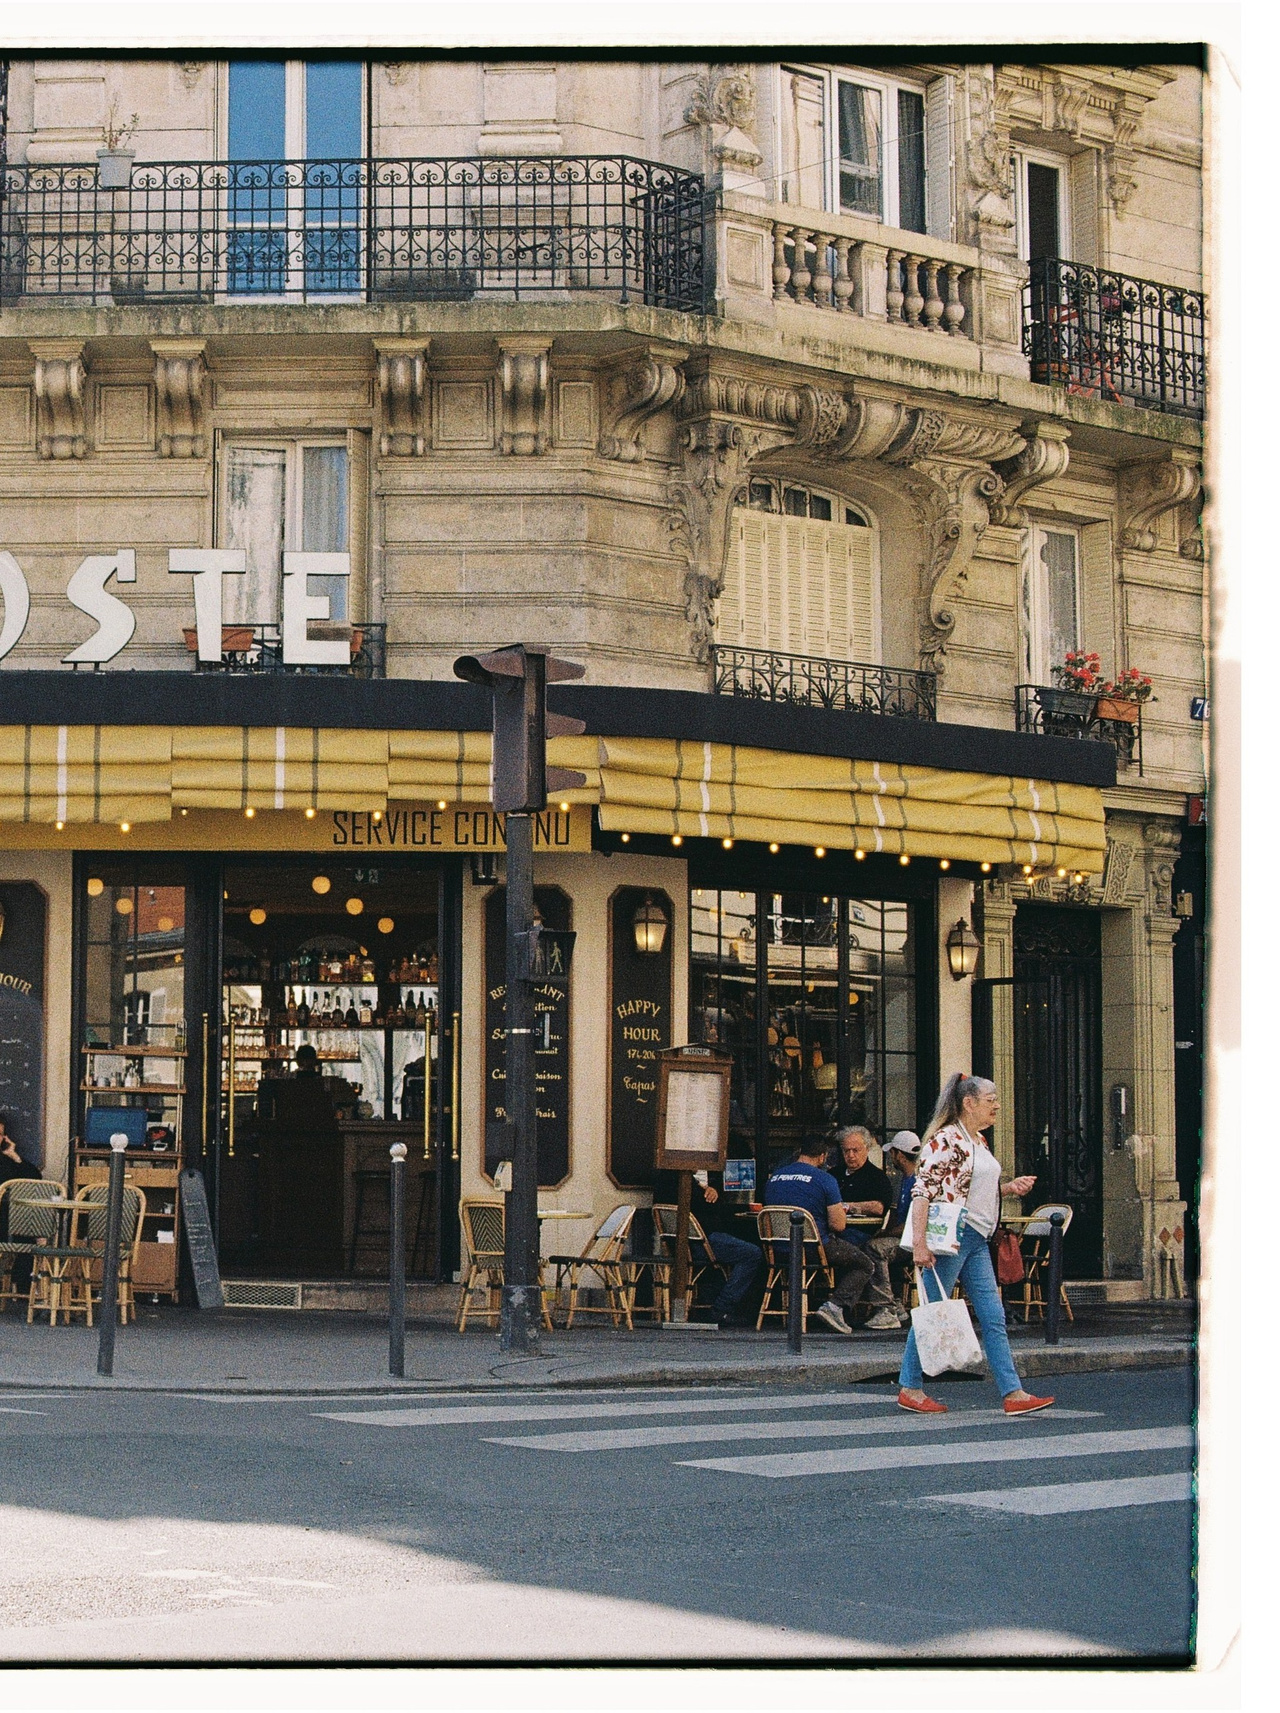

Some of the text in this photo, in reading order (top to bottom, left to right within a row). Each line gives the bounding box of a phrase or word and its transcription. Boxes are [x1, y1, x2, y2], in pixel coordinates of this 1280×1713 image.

[333, 810, 570, 846] SERVICE CONNU
[616, 1000, 661, 1019] HAPPY
[623, 1027, 661, 1042] HOUR
[623, 1076, 656, 1096] Tapas
